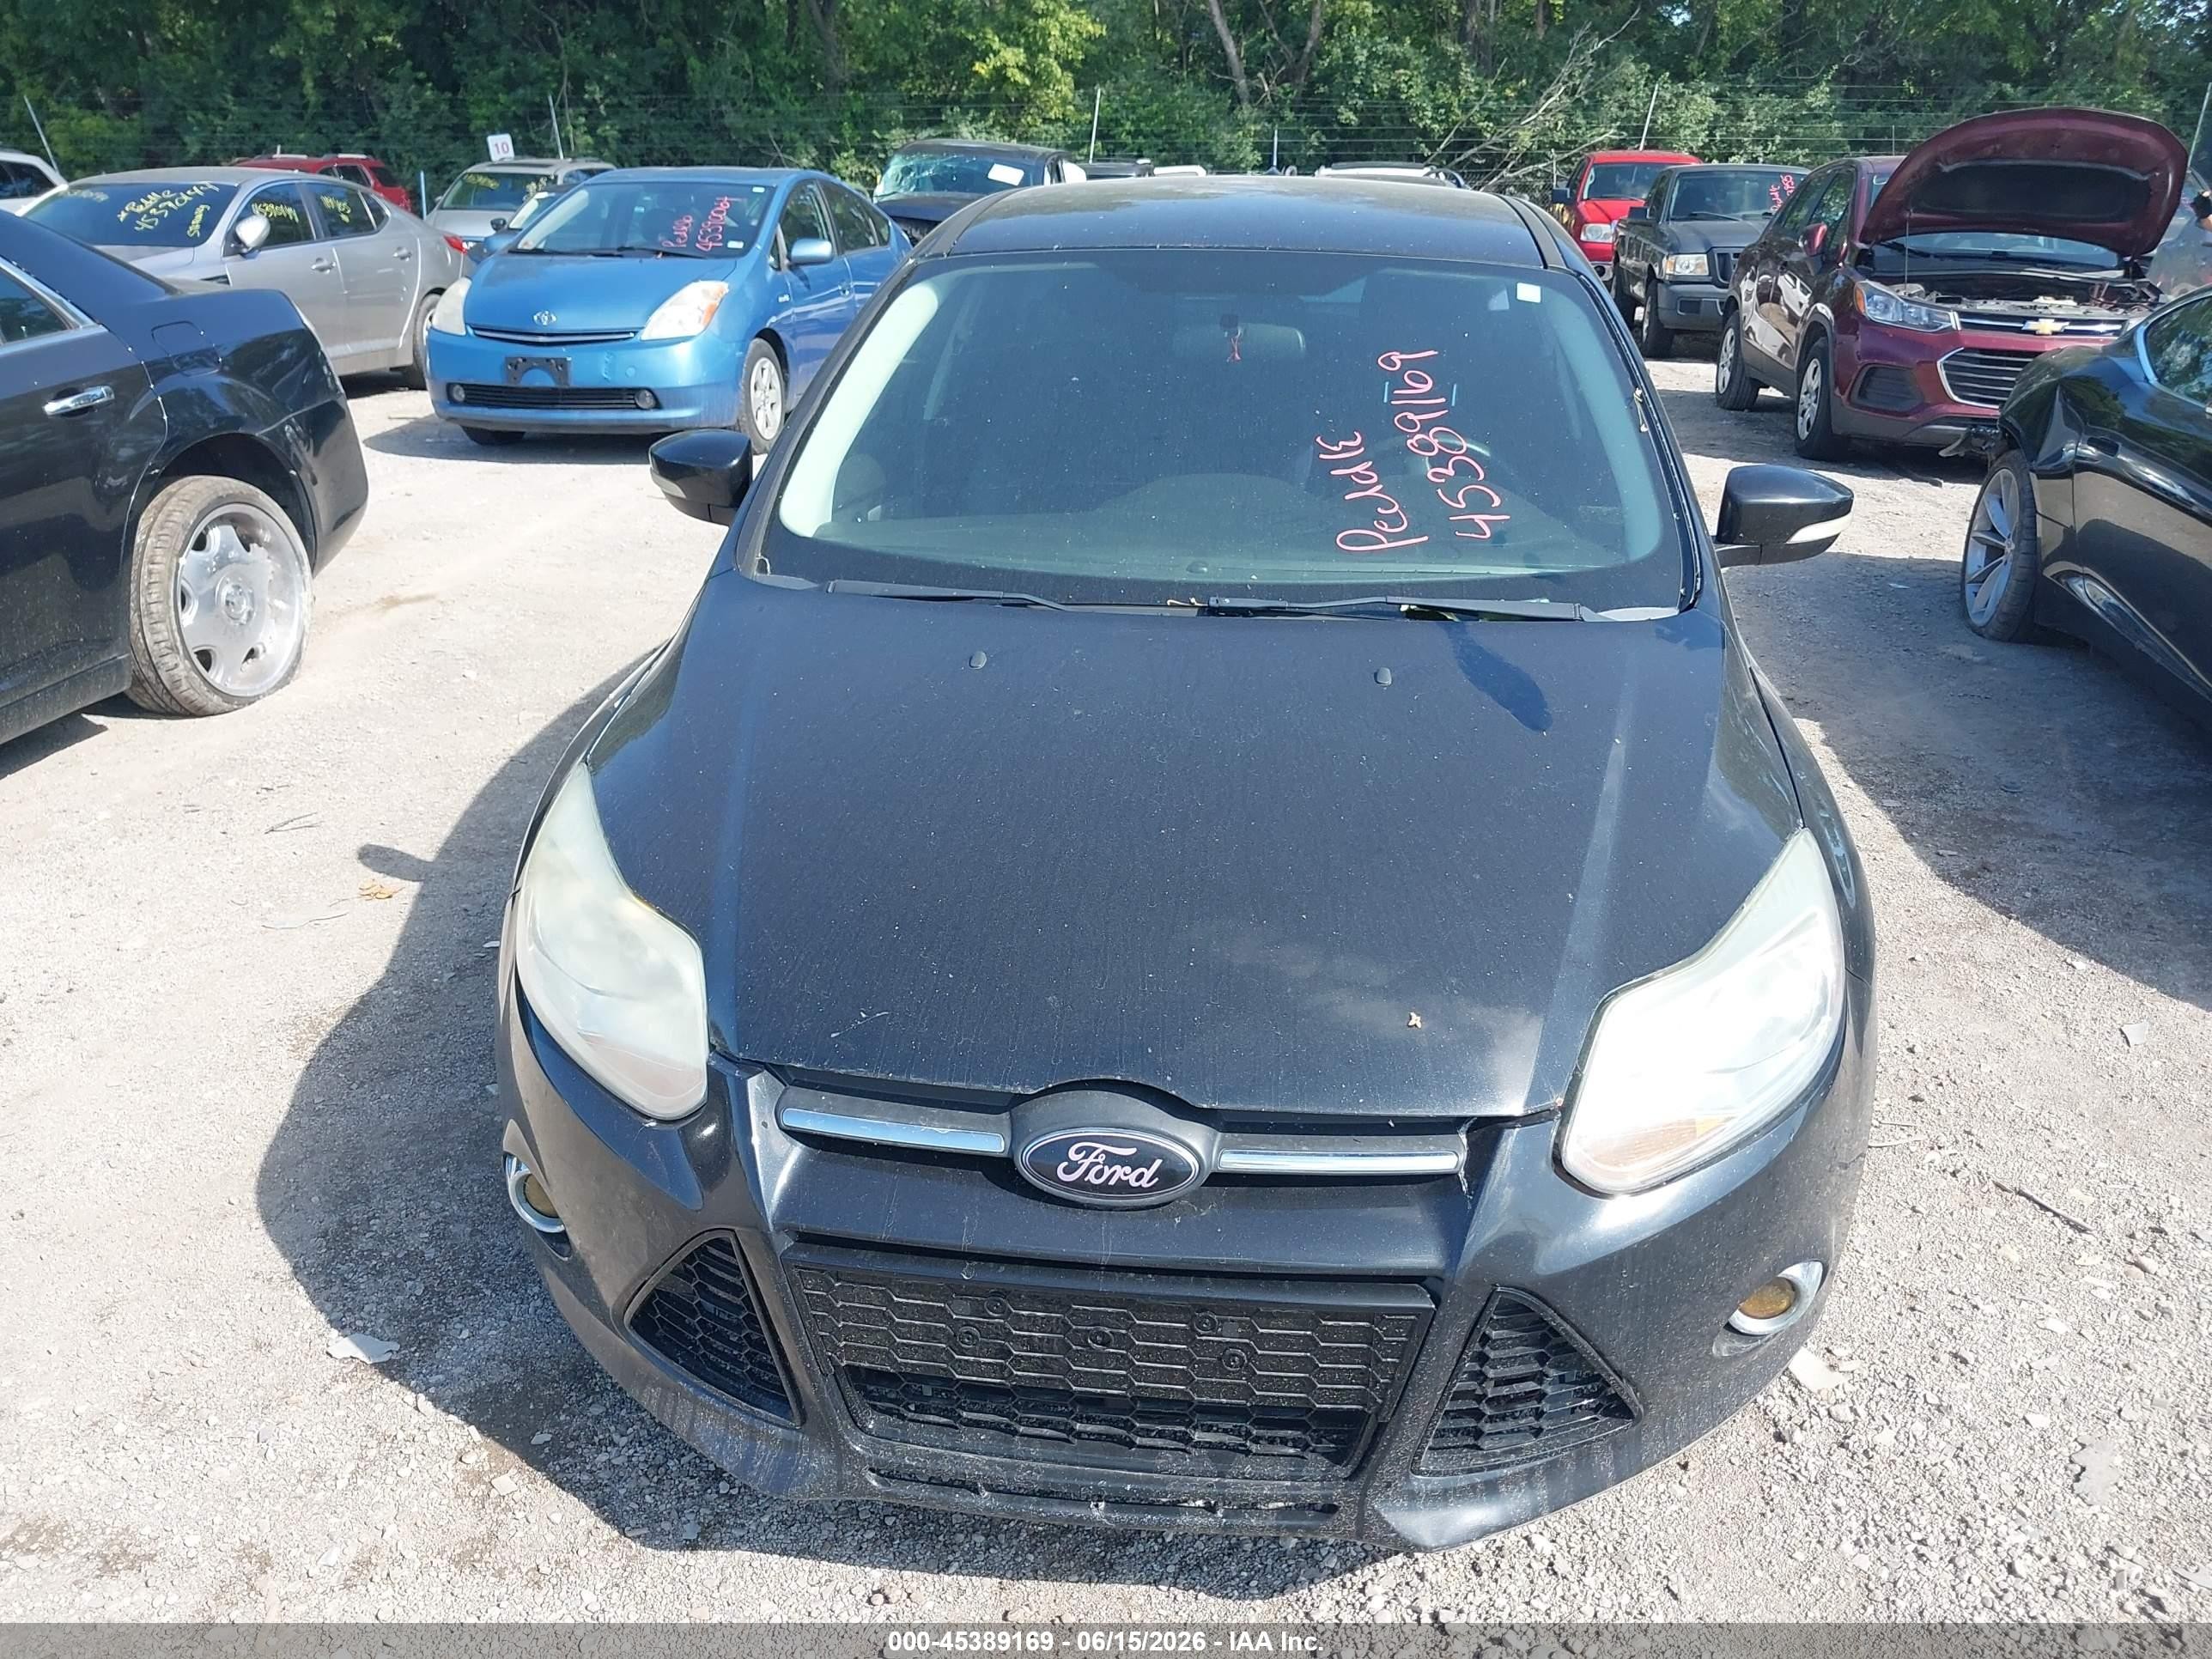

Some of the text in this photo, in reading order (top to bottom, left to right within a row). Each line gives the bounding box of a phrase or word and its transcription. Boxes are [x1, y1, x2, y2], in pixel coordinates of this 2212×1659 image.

[494, 141, 510, 155] 10
[1377, 349, 1511, 540] 45389169
[1056, 1140, 1164, 1188] Ford
